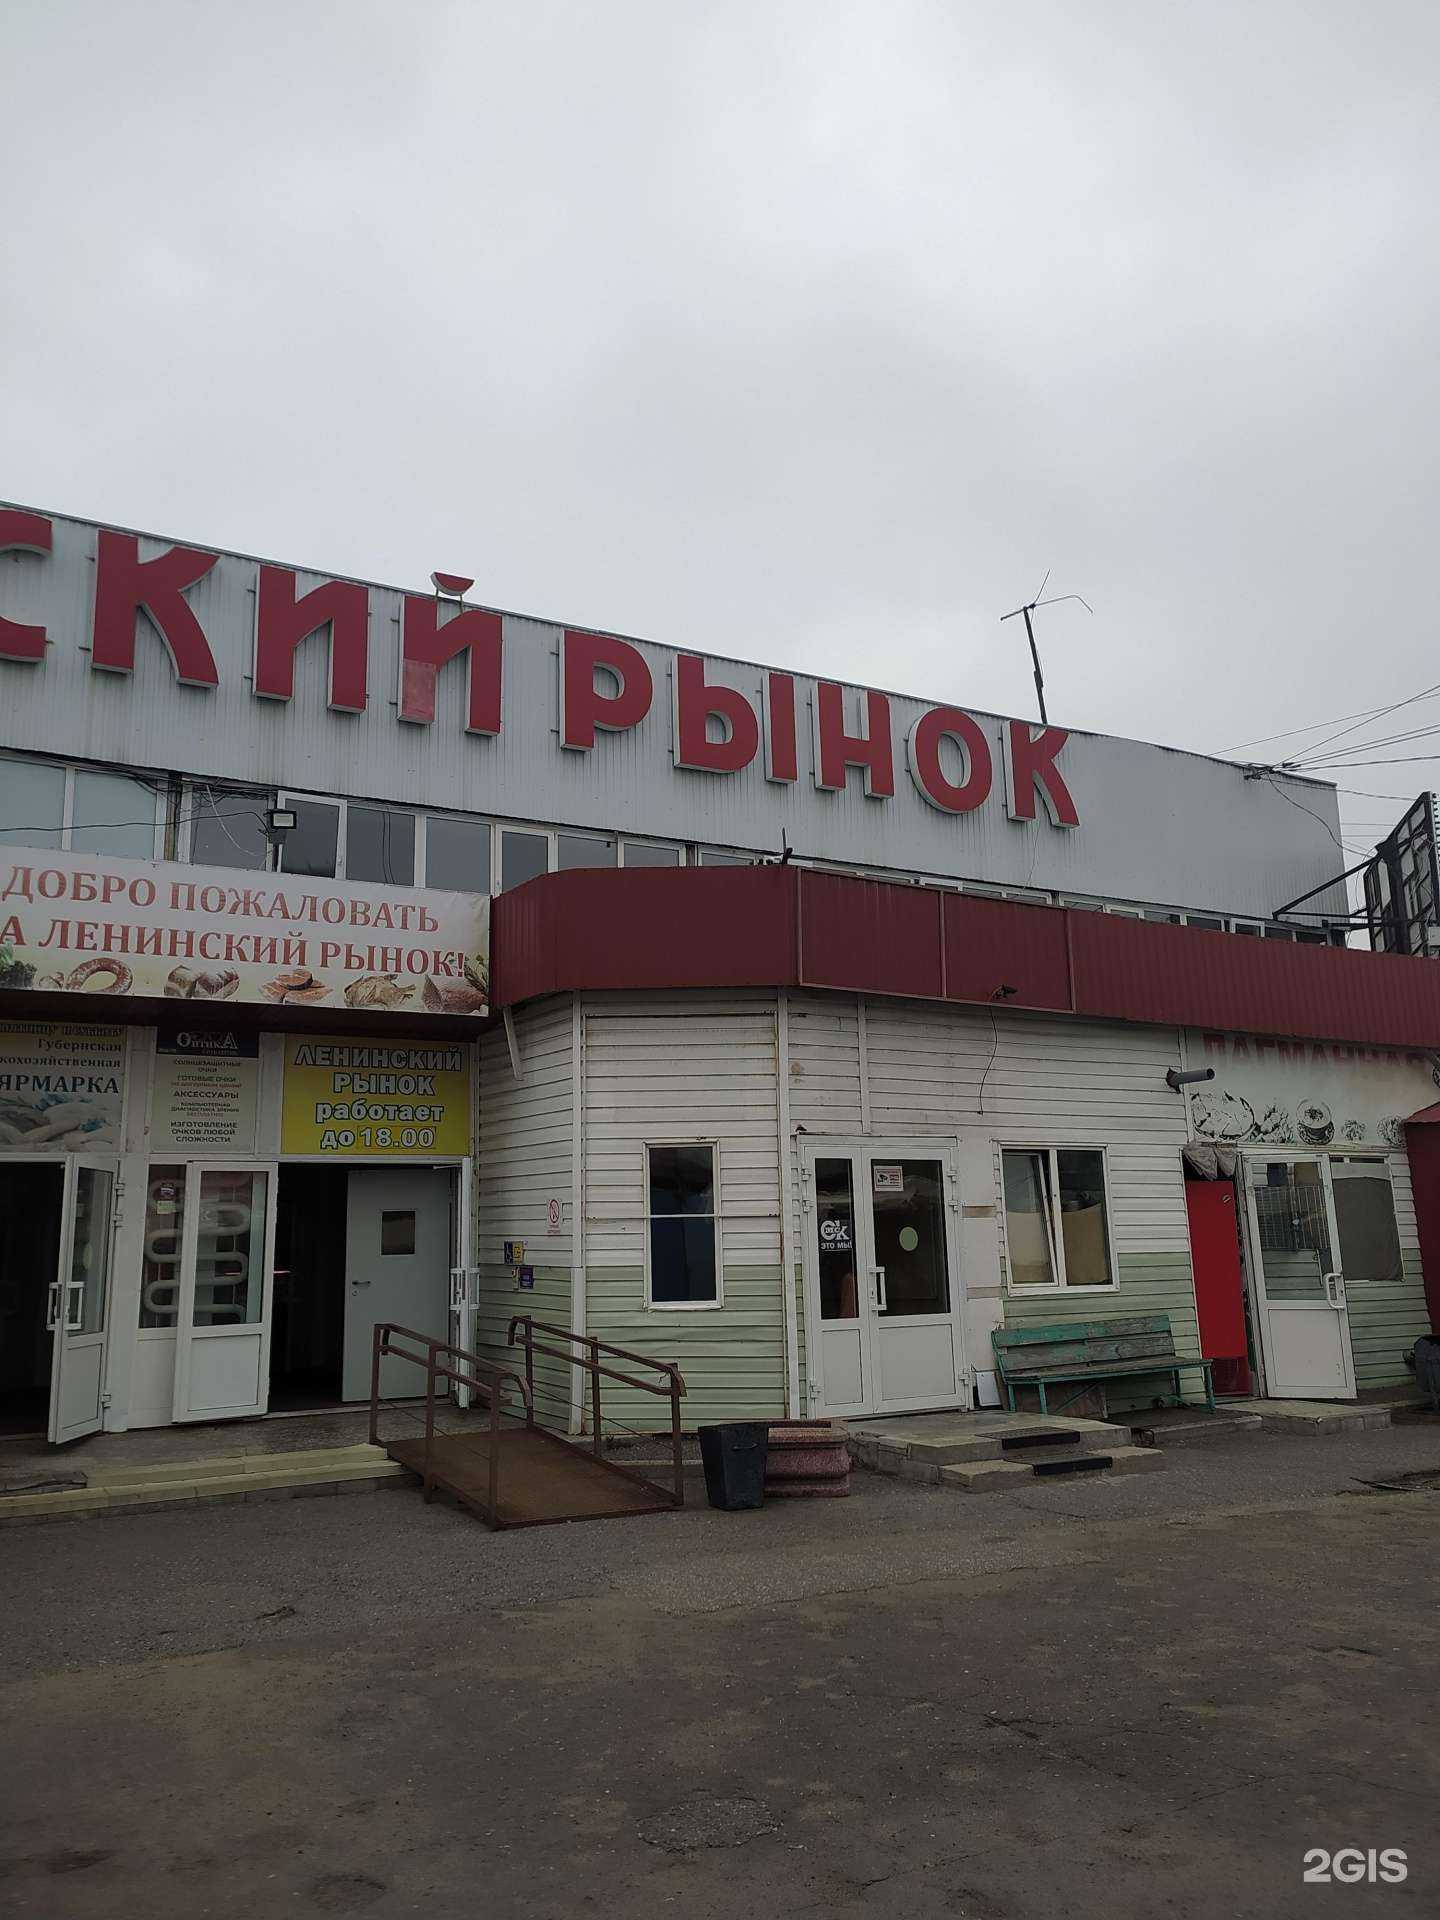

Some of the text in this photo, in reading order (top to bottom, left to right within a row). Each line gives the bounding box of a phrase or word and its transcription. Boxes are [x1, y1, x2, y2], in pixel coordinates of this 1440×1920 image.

[559, 629, 1080, 829] РЫНОК
[2, 866, 439, 933] ДОБРО ПОЖАЛОВАТЬ
[38, 918, 307, 967] ЛЕНИНСКИЙ
[320, 941, 466, 977] РЫНОК!
[38, 1038, 121, 1052] Губернская
[295, 1045, 464, 1071] ЛЕНИНСКИЙ
[0, 1074, 119, 1094] ЯРМАРКА
[174, 1091, 239, 1099] АКСЕССУАРЫ
[333, 1072, 436, 1096] РЫНОК
[315, 1099, 444, 1124] работает
[170, 1121, 238, 1129] ИЗГОТОВЛЕНИЕ
[203, 1128, 236, 1136] ЛЮБОЙ
[320, 1127, 436, 1150] до 18.00
